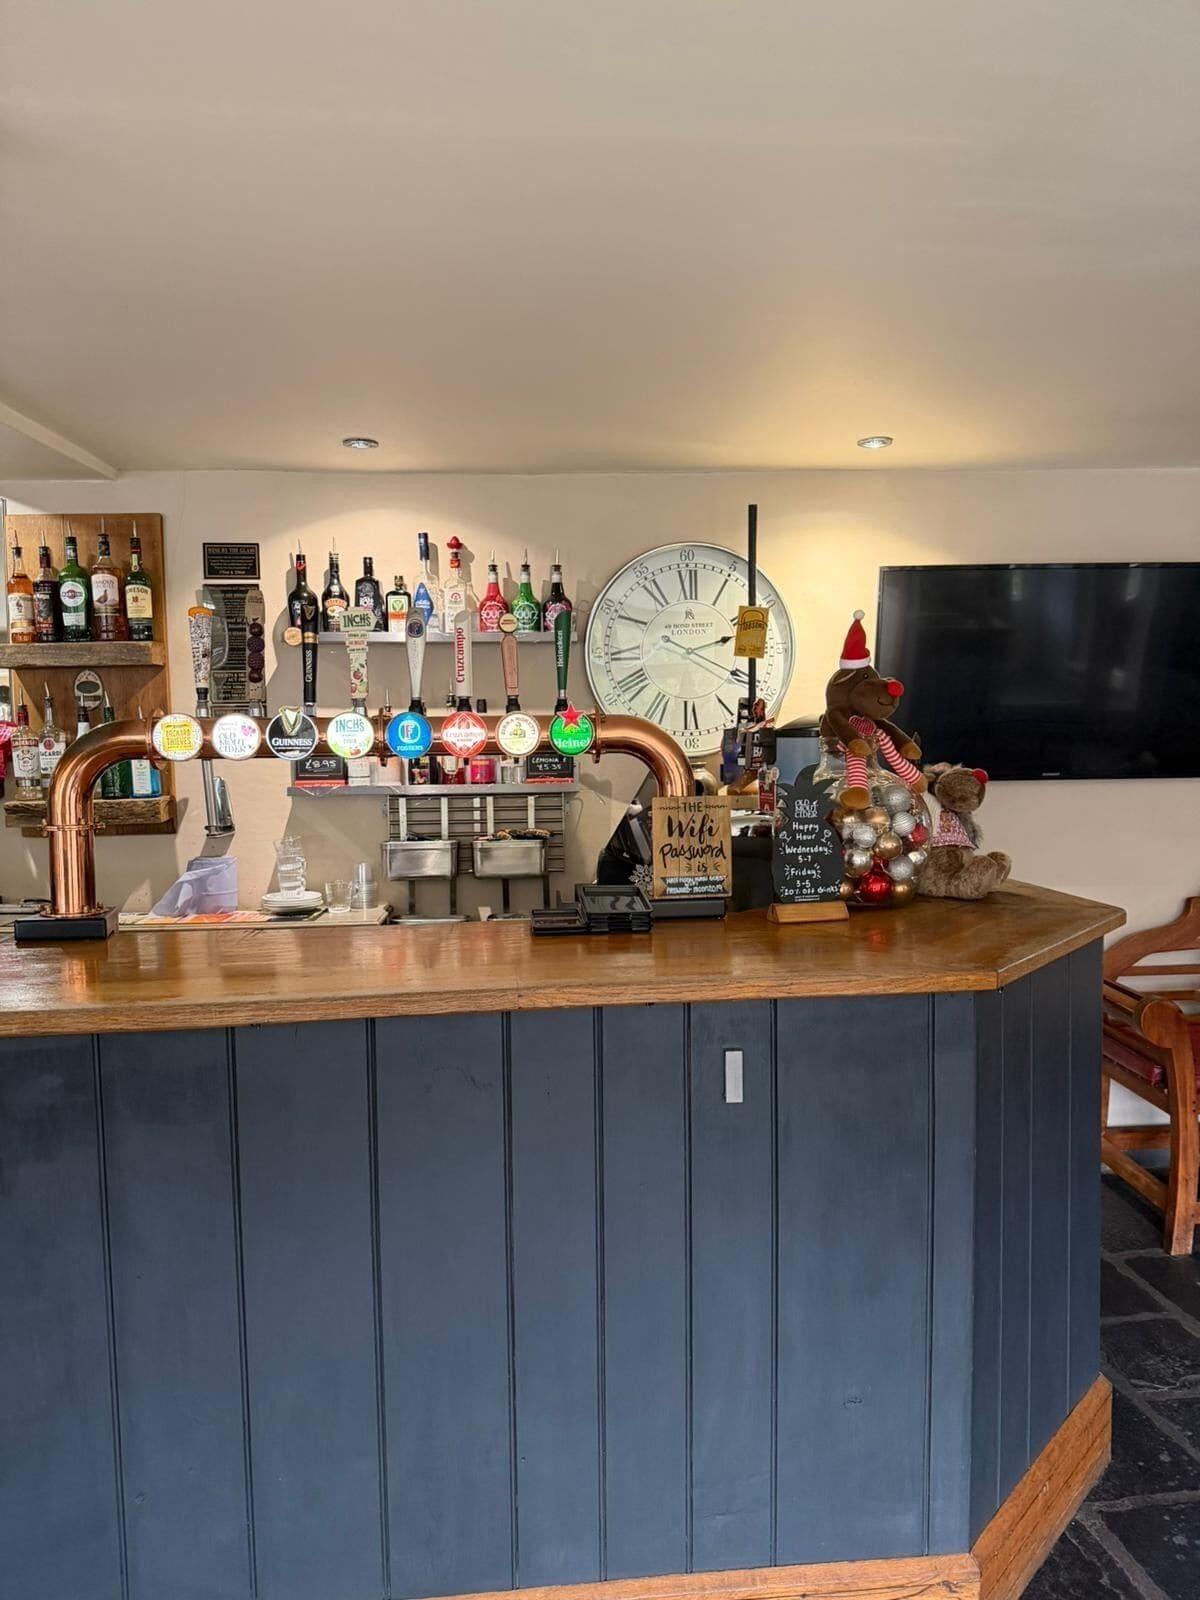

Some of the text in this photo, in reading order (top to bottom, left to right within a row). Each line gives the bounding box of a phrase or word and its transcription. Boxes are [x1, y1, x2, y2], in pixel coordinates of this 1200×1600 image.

[680, 550, 694, 562] 60
[632, 562, 650, 578] 55
[728, 560, 738, 572] 5
[456, 627, 466, 684] Cruzcampo
[167, 738, 192, 746] THIEVES
[272, 738, 312, 746] GUINNESS
[681, 802, 704, 812] THE
[668, 814, 720, 844] Wifi
[792, 821, 819, 832] Happy
[796, 832, 816, 840] Hour
[659, 840, 726, 868] Password
[785, 844, 829, 855] Wednesday
[697, 862, 708, 872] is
[790, 868, 818, 878] Friday
[796, 880, 811, 888] 3-5
